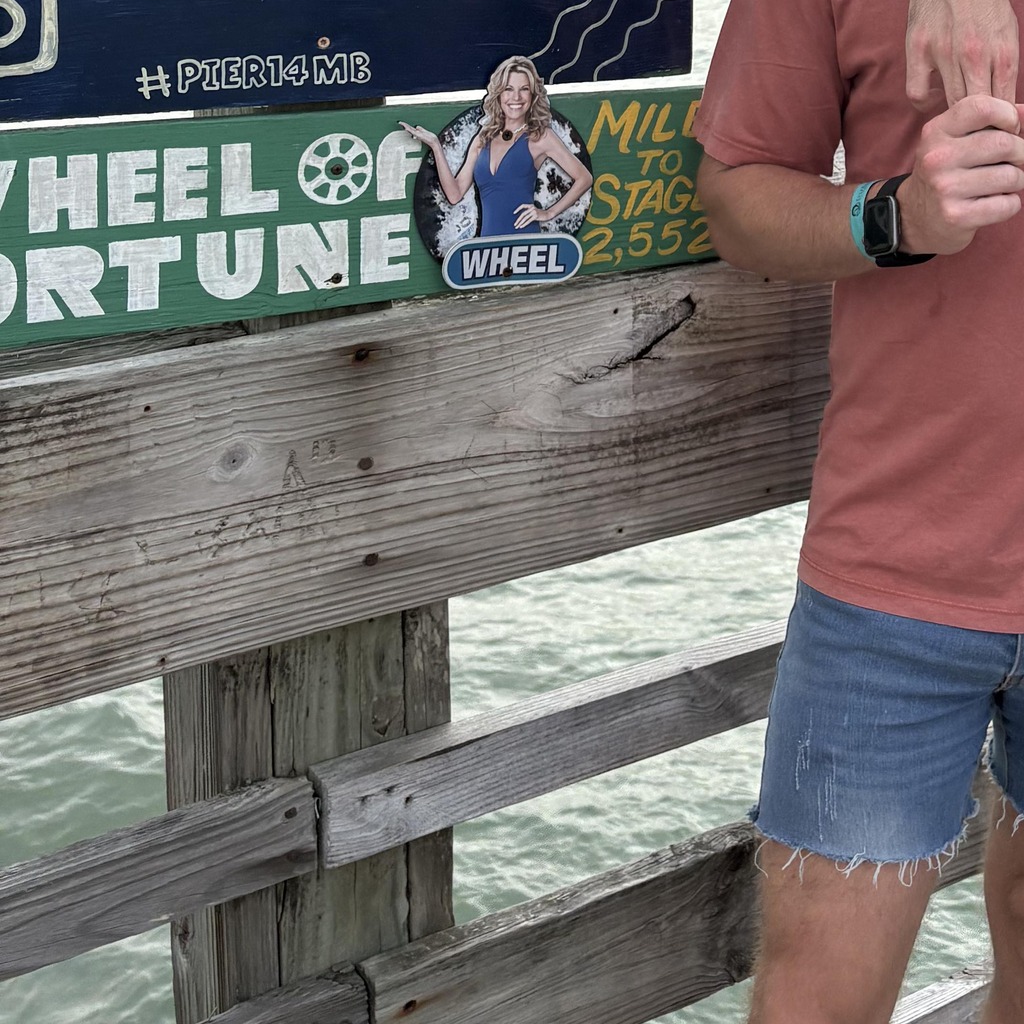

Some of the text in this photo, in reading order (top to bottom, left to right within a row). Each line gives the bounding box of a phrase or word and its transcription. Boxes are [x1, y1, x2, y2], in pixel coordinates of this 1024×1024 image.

[136, 51, 372, 100] #PIER14MB
[637, 149, 683, 176] TO
[0, 213, 411, 325] RTUNE
[461, 242, 566, 281] WHEEL
